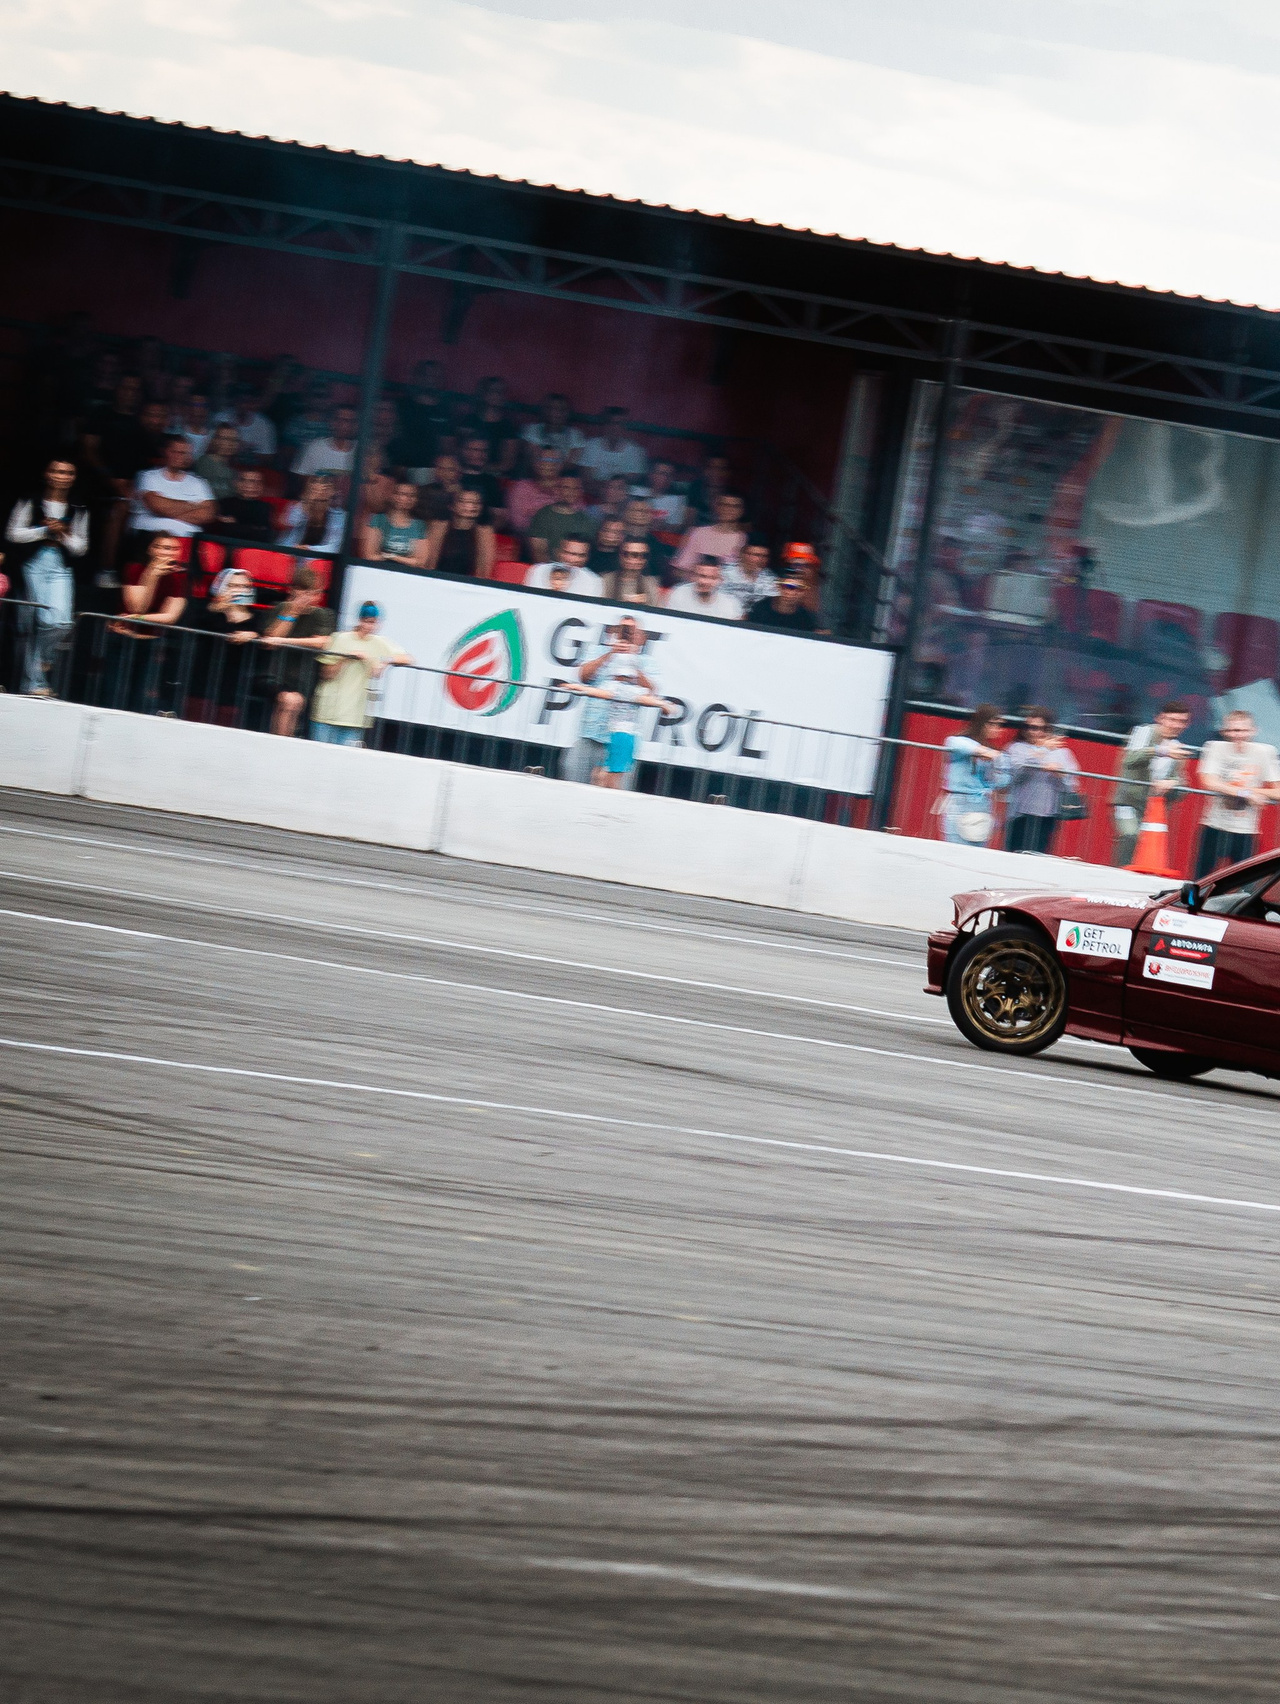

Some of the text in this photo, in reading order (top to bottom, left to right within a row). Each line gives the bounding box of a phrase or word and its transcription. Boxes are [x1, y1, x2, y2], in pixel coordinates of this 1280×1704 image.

[534, 678, 768, 759] PROL
[1083, 927, 1105, 940] GET
[1082, 940, 1122, 955] PETROL
